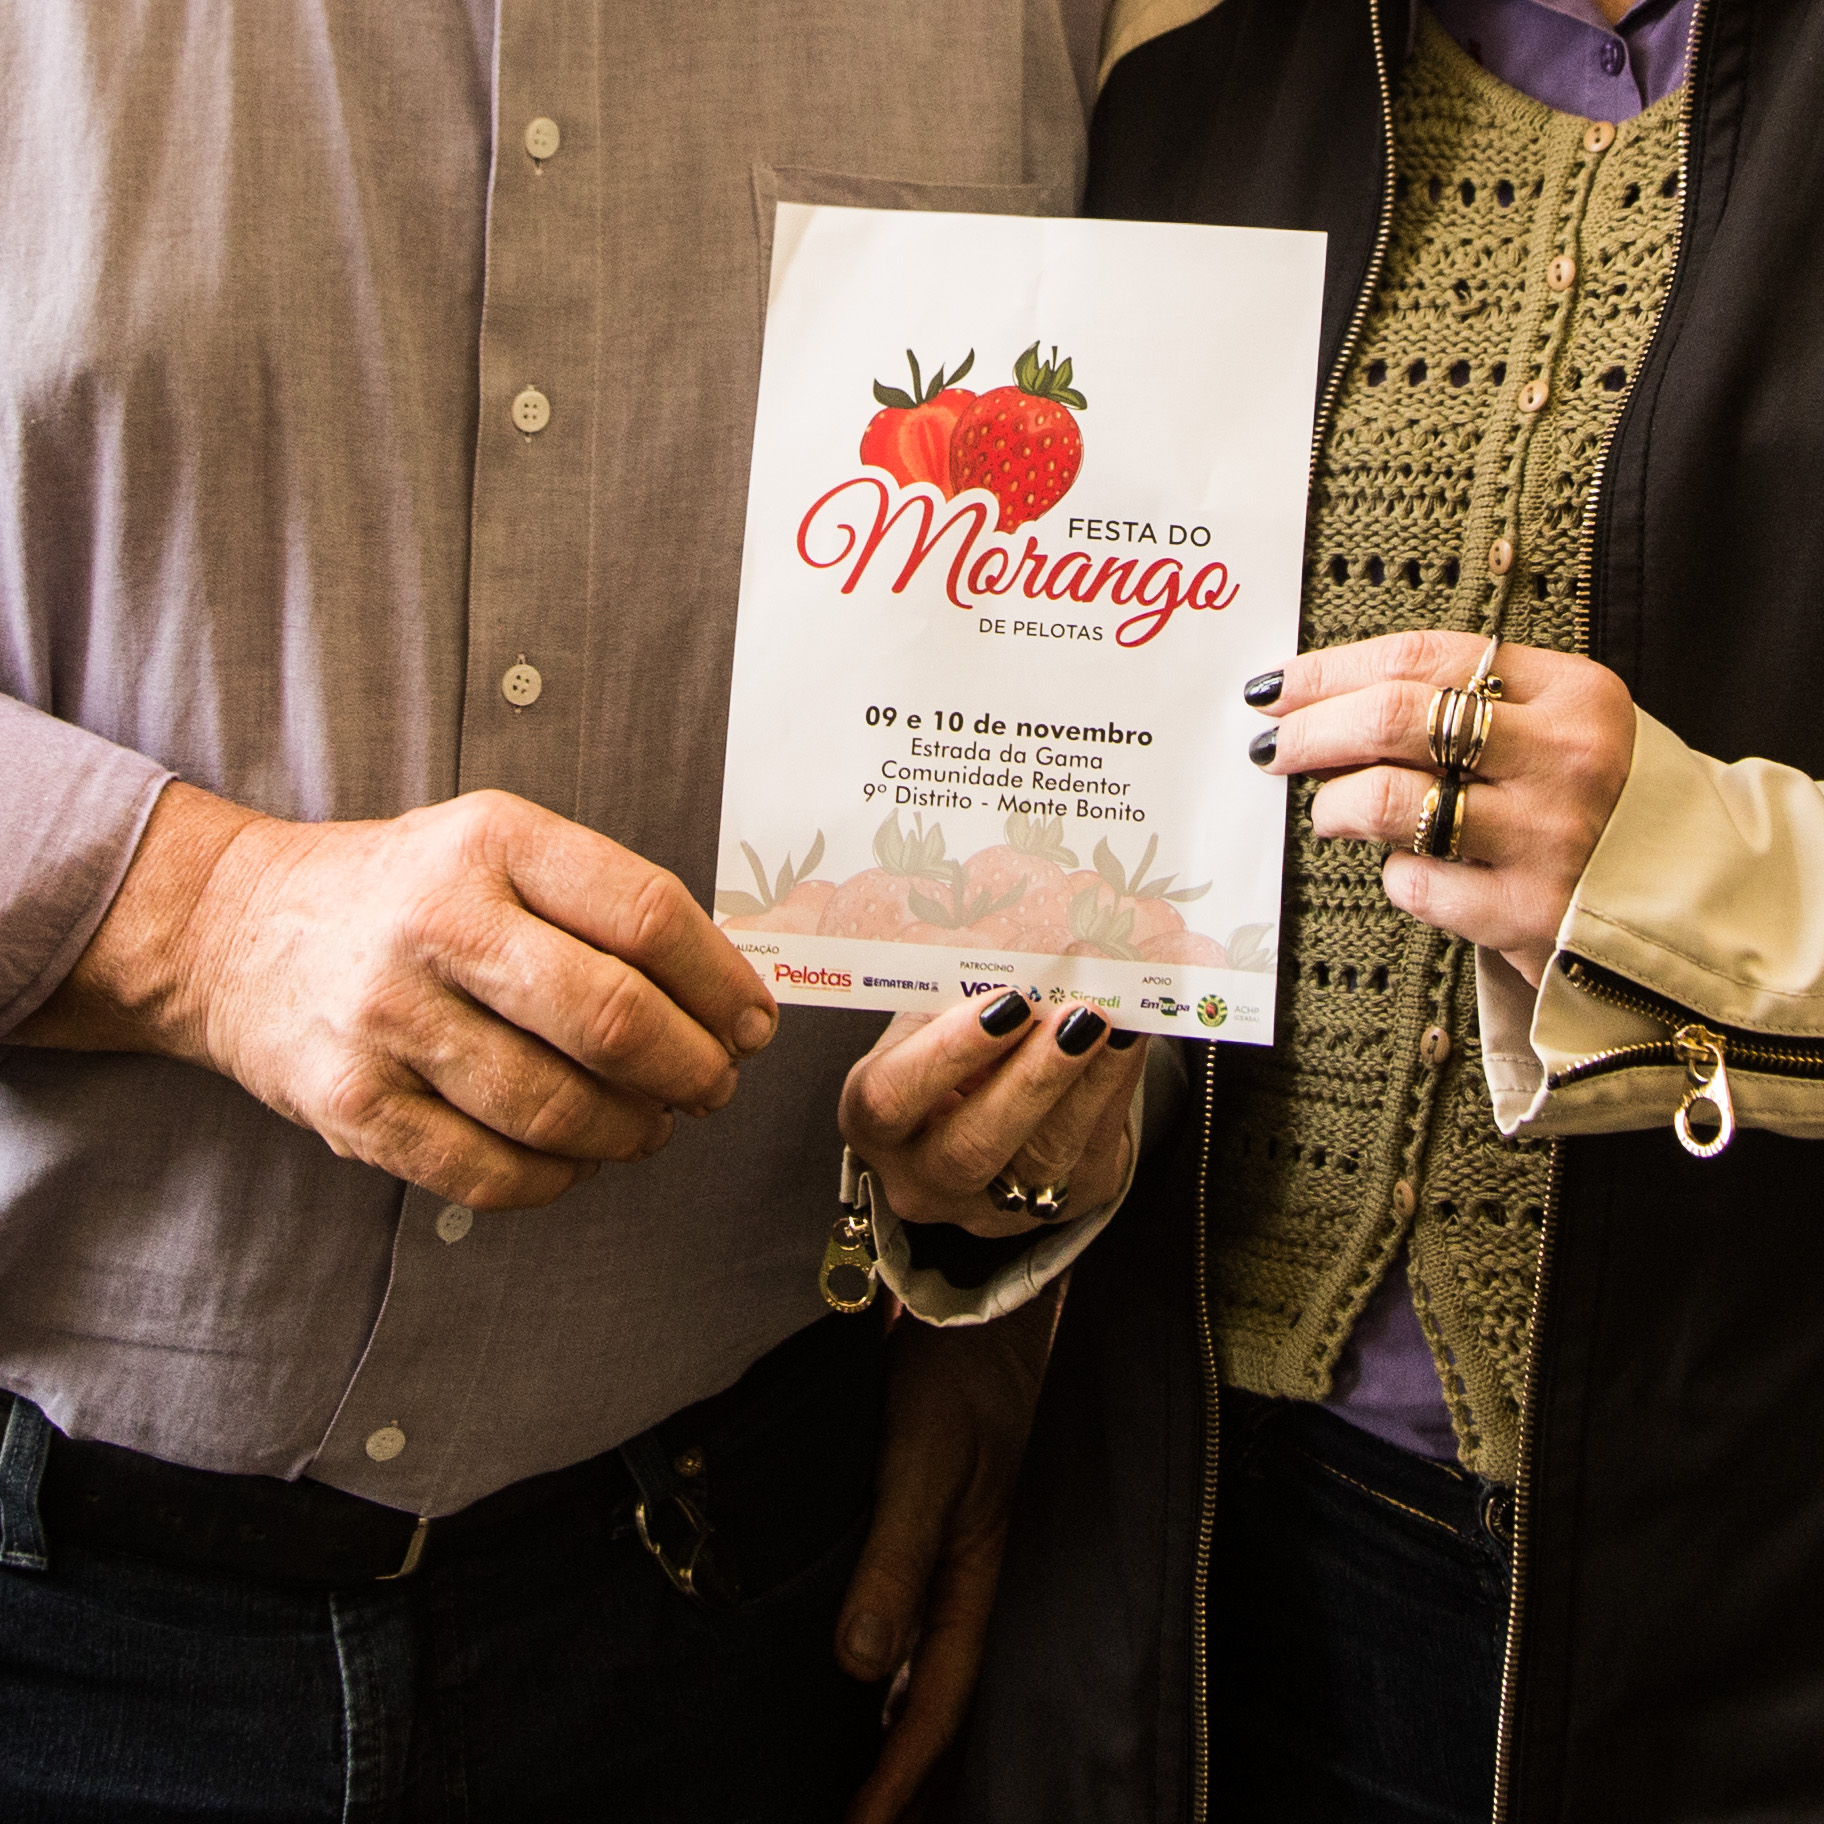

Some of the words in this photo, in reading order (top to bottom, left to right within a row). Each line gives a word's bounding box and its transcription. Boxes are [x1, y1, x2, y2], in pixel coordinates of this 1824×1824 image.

[1068, 518, 1157, 544] FESTA
[1169, 525, 1212, 547] DO
[796, 477, 1241, 648] Morango
[979, 618, 1006, 635] DE
[1013, 621, 1103, 641] PELOTAS
[865, 706, 897, 727] 09
[907, 714, 922, 729] e
[934, 710, 964, 732] 10
[973, 713, 1006, 735] de
[1016, 722, 1153, 746] novembro
[911, 738, 991, 761] Estrada
[999, 744, 1026, 763] da
[1036, 747, 1103, 769] Gama
[881, 760, 1023, 788] Comunidade
[1032, 771, 1131, 796] Redentor
[895, 785, 972, 809] Distrito
[997, 794, 1068, 817] Monte
[1076, 799, 1146, 822] Bonito
[733, 943, 780, 955] ALIZAÇÃO
[774, 963, 852, 987] Pelotas
[959, 961, 1014, 973] PATROCÍNIO
[874, 977, 930, 991] EMATER/RS
[1142, 977, 1172, 985] APOIO
